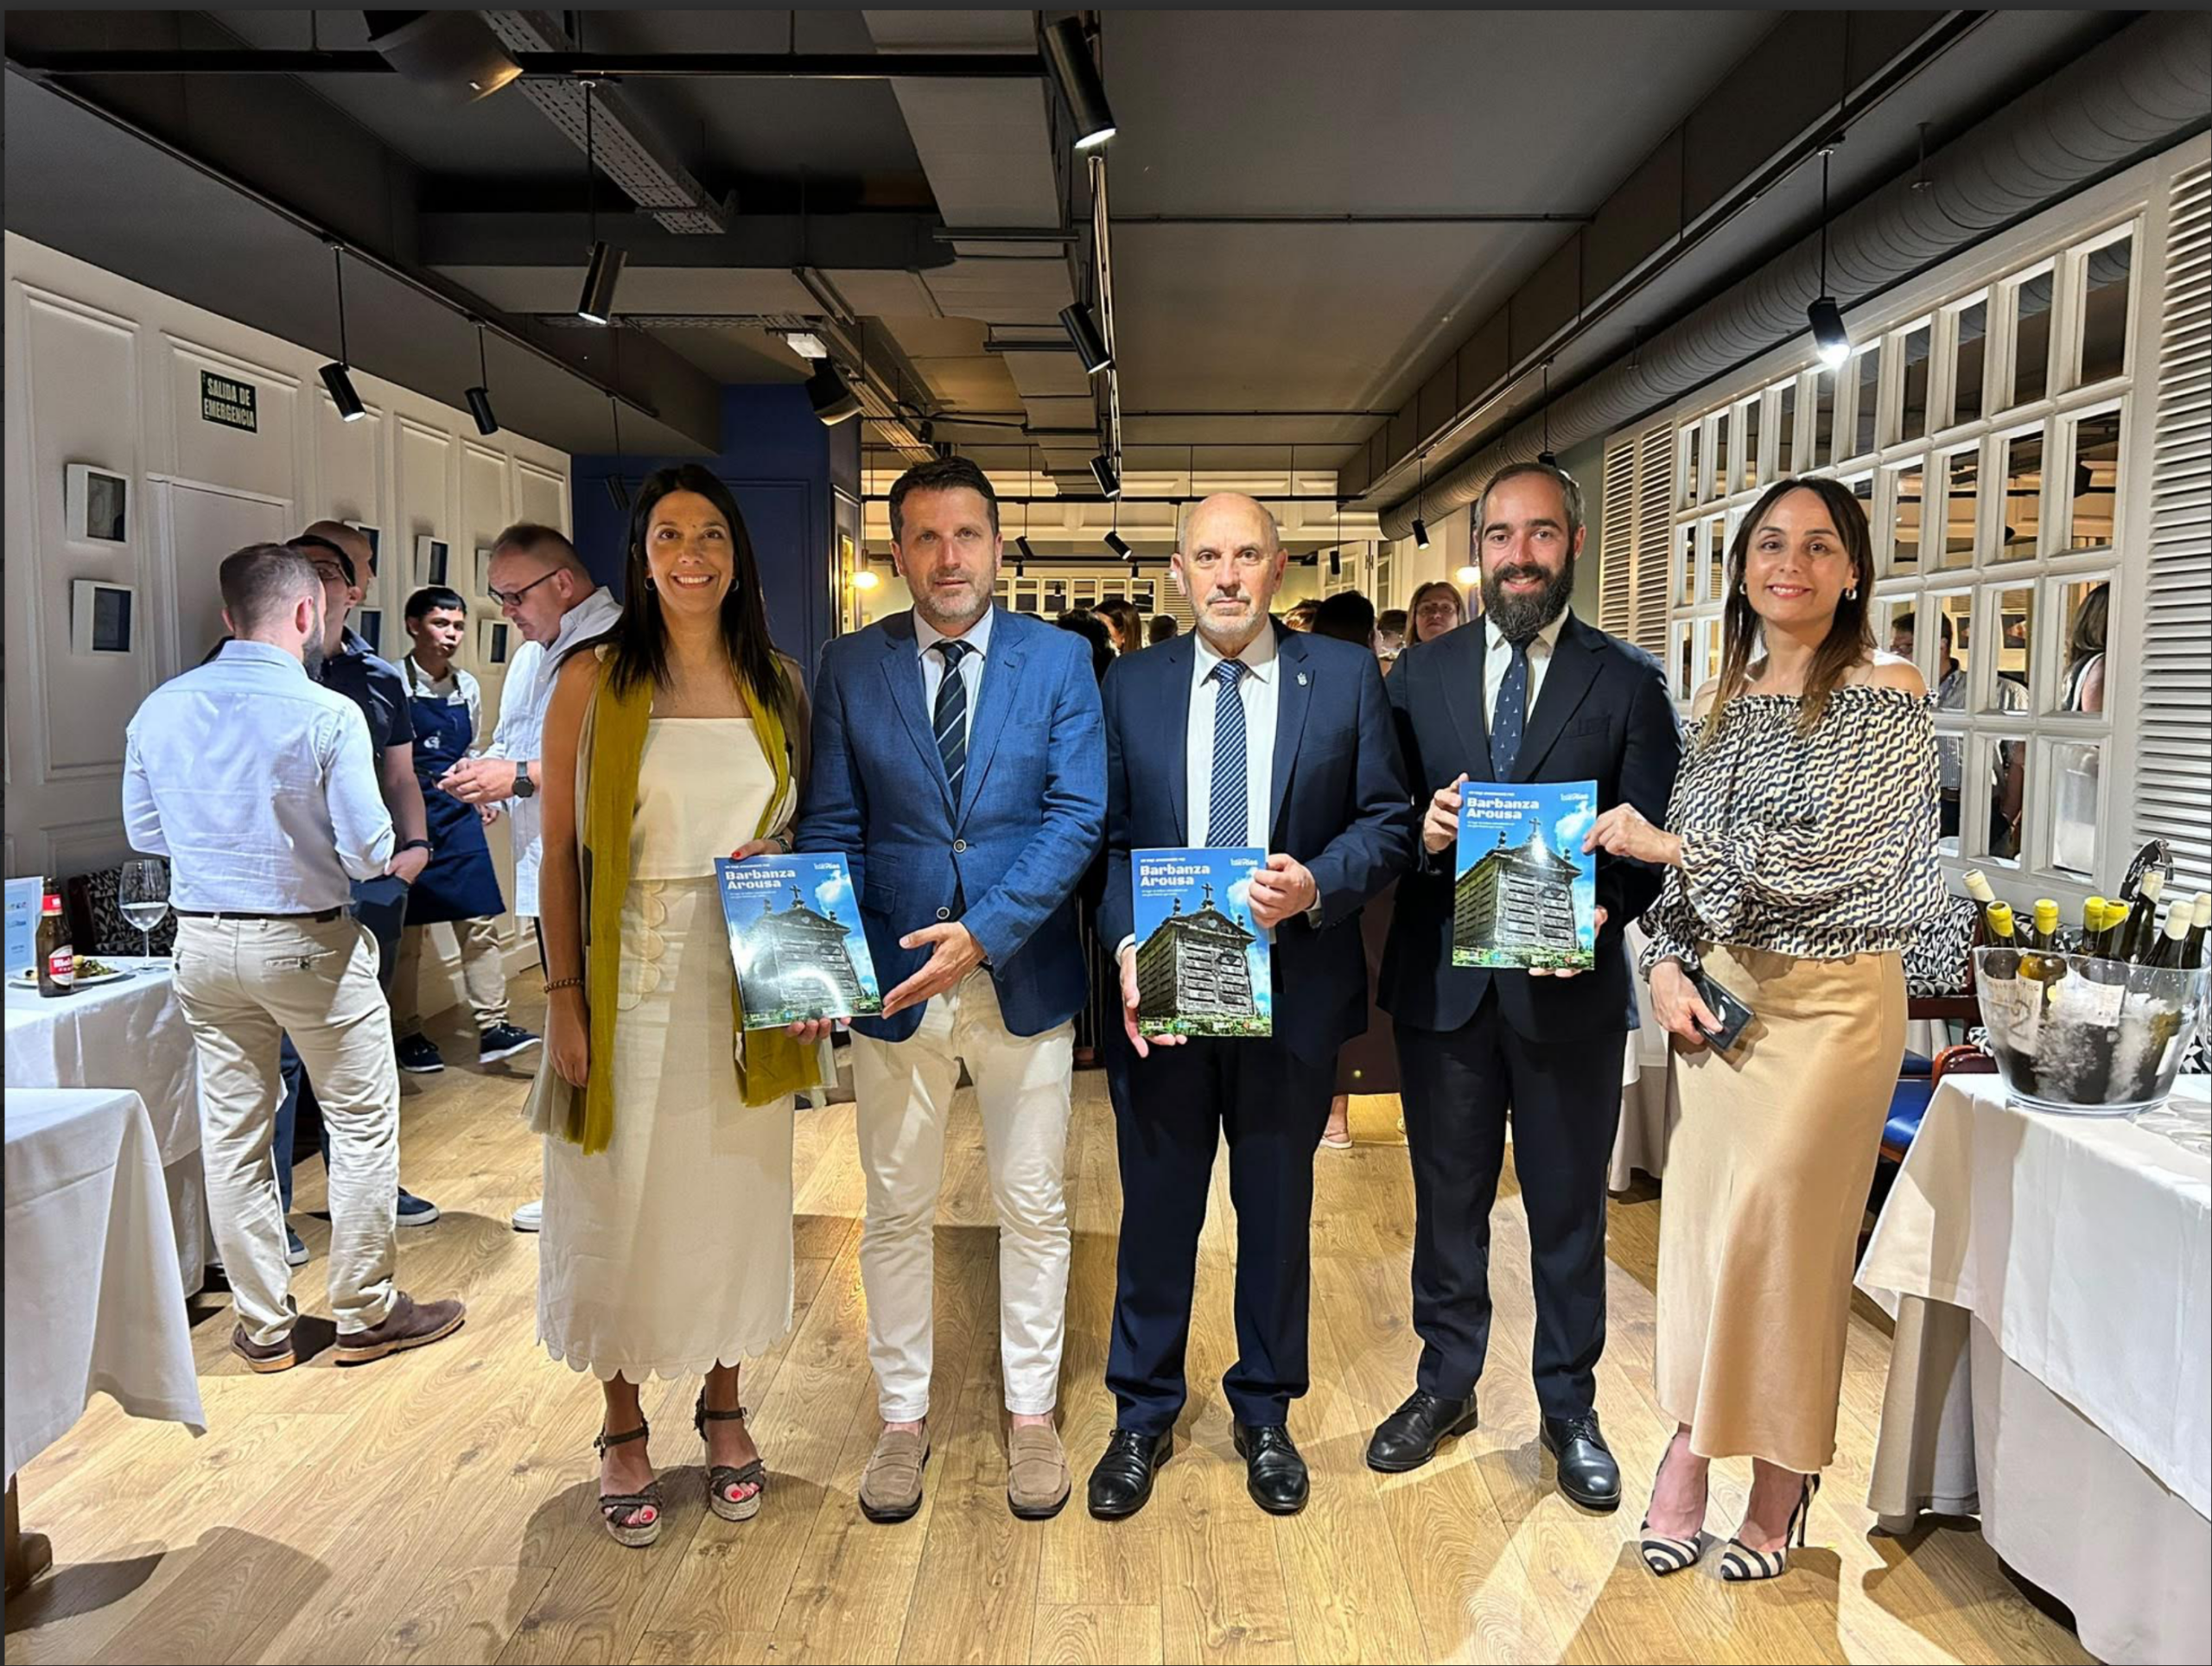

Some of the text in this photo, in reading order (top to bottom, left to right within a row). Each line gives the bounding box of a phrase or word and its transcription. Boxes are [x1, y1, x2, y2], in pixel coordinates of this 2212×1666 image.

[207, 377, 251, 406] SALIDA DE
[204, 397, 255, 428] EMERGENCIA
[1467, 797, 1539, 809] Barbanza
[1466, 808, 1522, 819] Arousa
[725, 869, 796, 880] Barbanza
[1140, 864, 1211, 875] Barbanza
[728, 880, 782, 889] Arousa
[1141, 875, 1194, 886] Arousa
